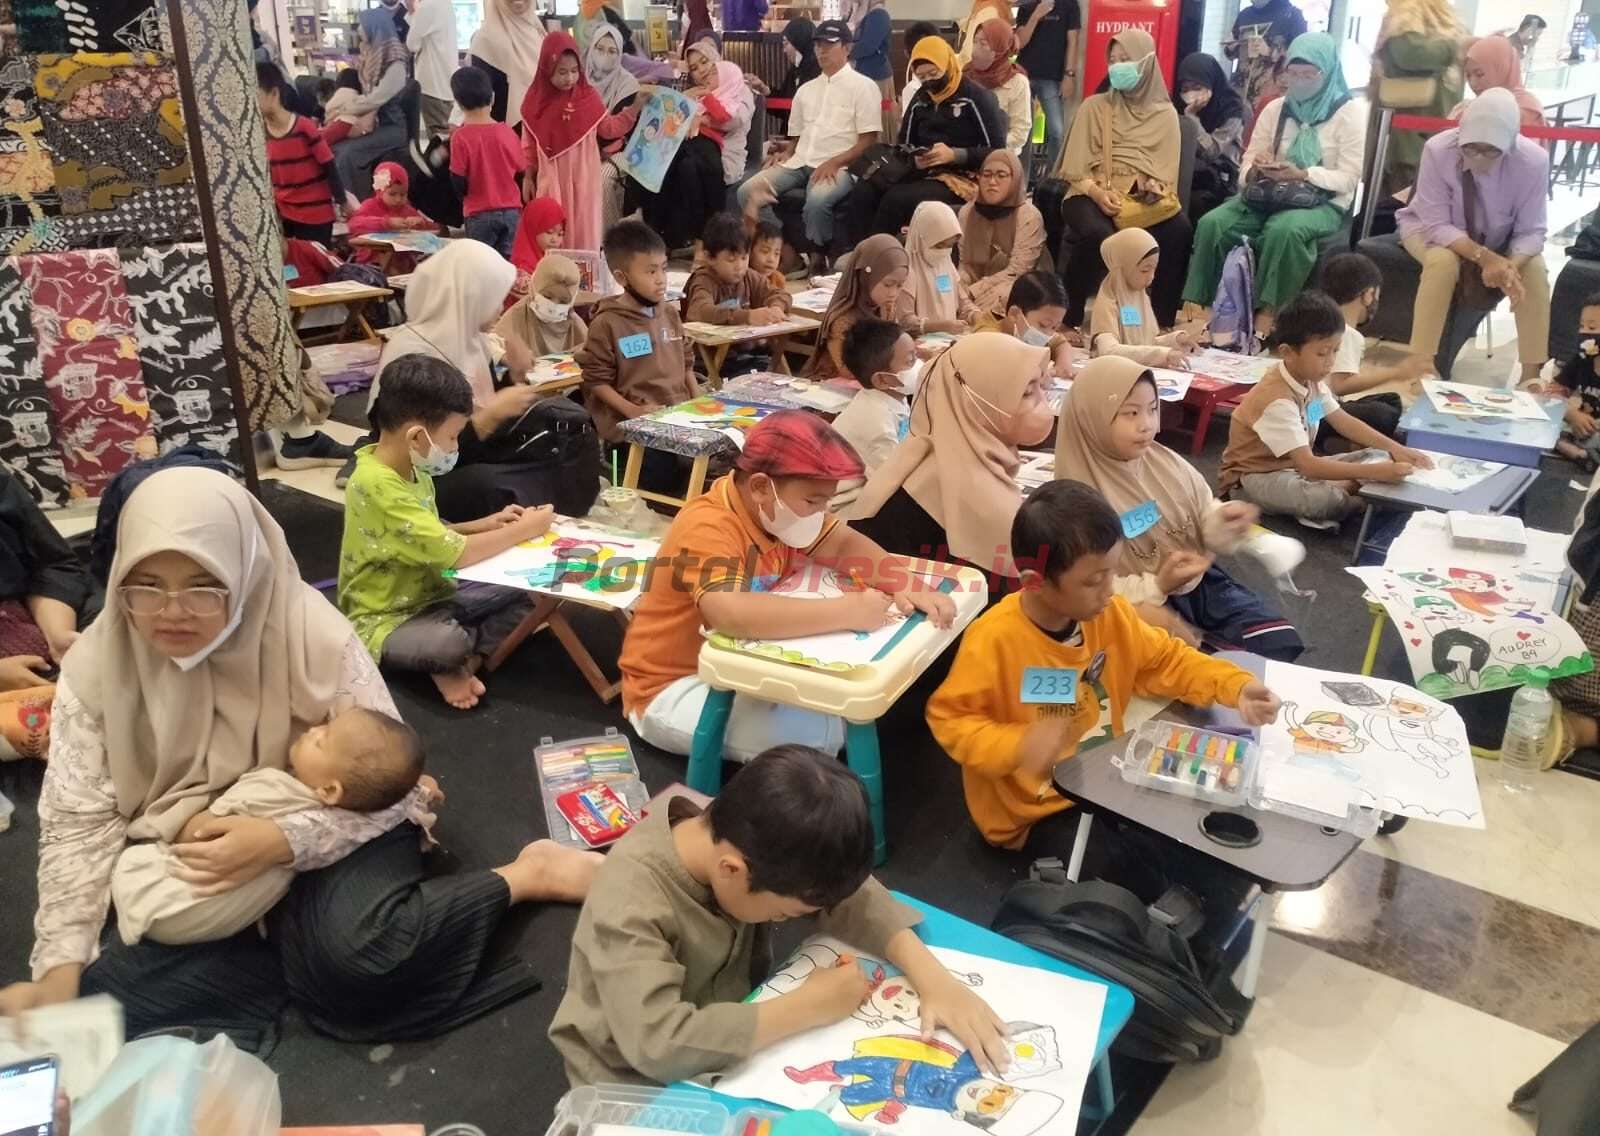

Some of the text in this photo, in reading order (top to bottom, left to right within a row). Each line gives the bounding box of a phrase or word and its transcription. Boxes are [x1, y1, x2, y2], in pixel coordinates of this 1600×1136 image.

[1096, 21, 1155, 33] HYDRANT
[624, 338, 649, 354] 162
[1127, 507, 1154, 531] 156
[1499, 638, 1547, 654] AUDREY
[1030, 675, 1072, 695] 233
